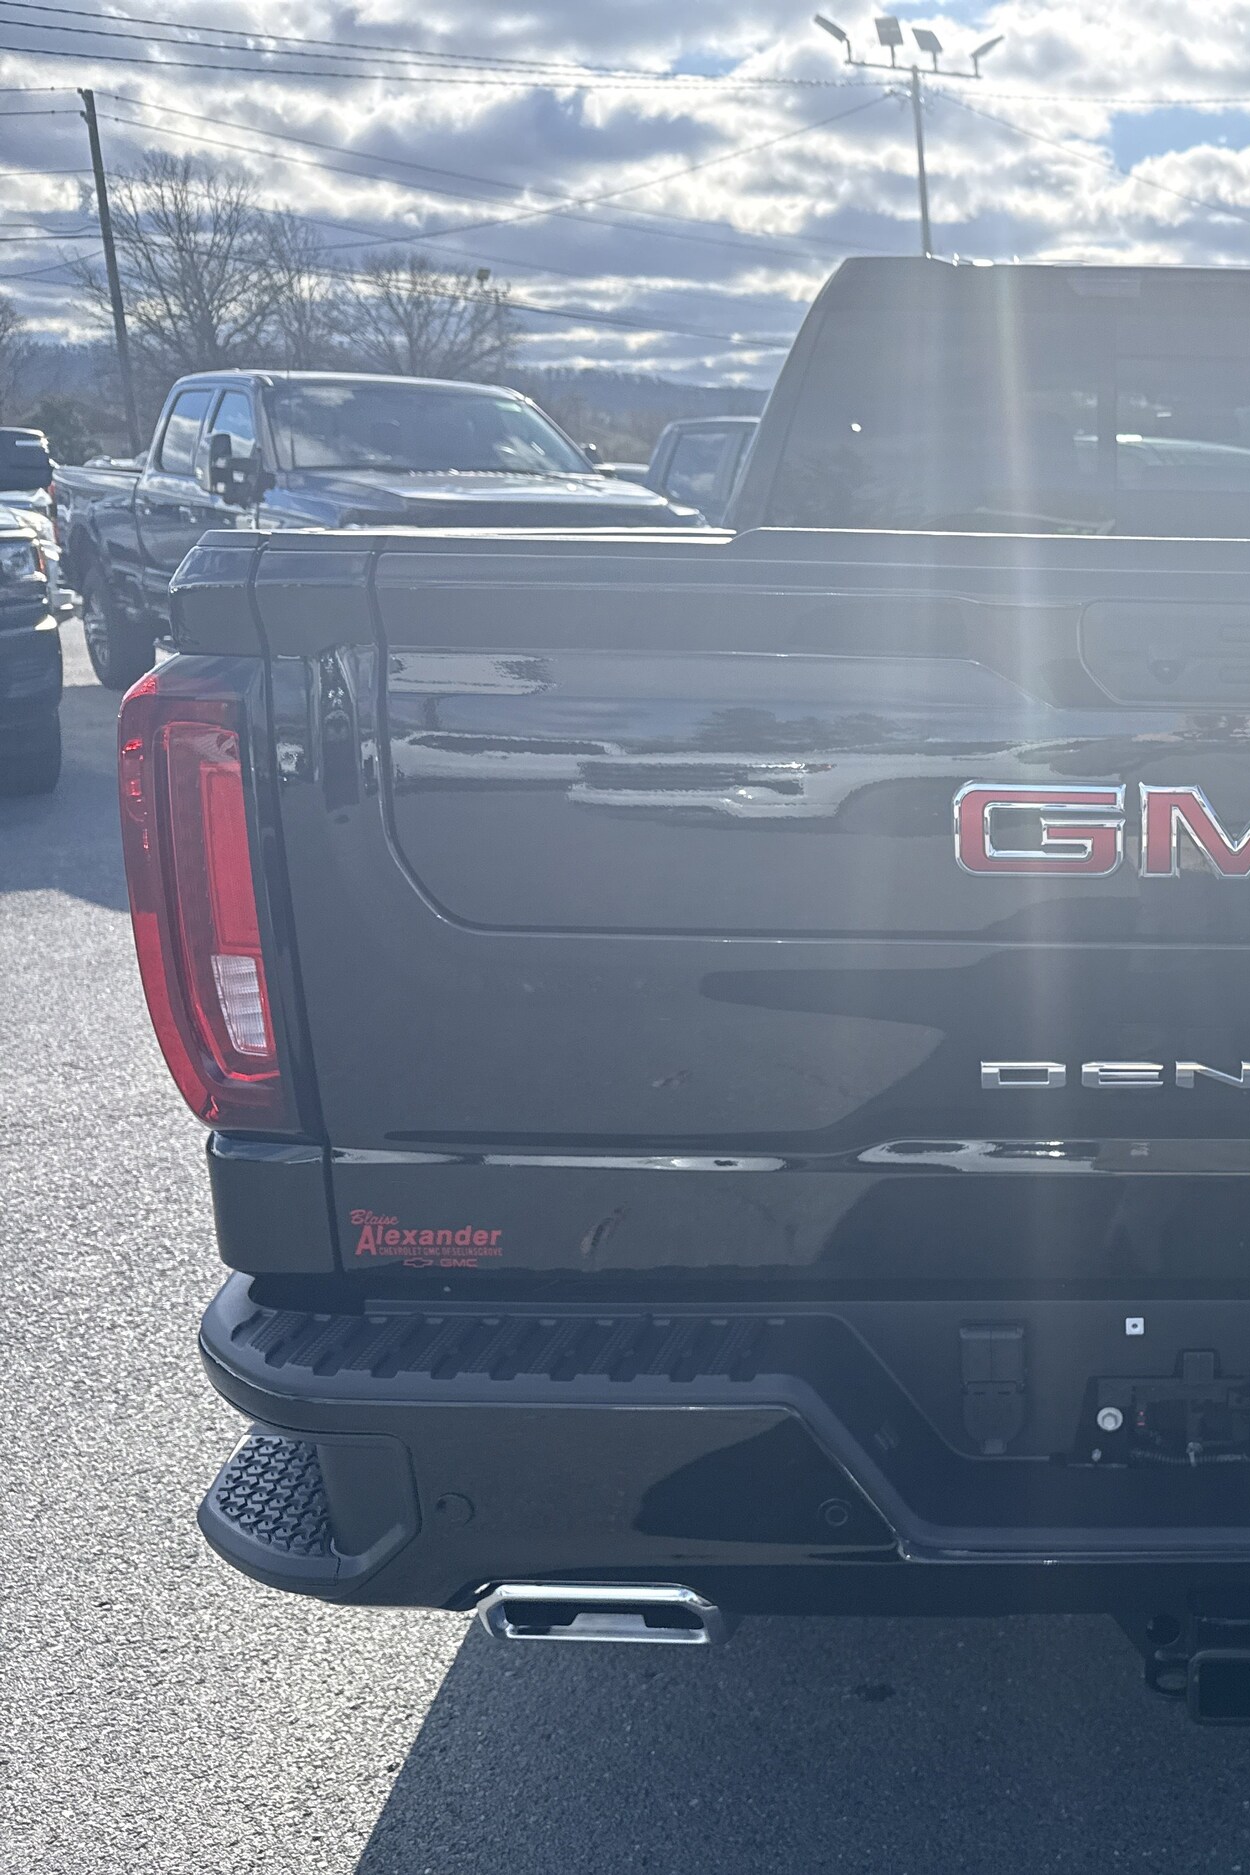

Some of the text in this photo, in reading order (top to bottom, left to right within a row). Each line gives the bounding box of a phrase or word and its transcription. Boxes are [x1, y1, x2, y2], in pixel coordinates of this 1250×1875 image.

[350, 1208, 399, 1226] Blaise
[355, 1225, 502, 1256] Alexander
[379, 1247, 421, 1256] CHEVROLET
[440, 1258, 478, 1268] GMC
